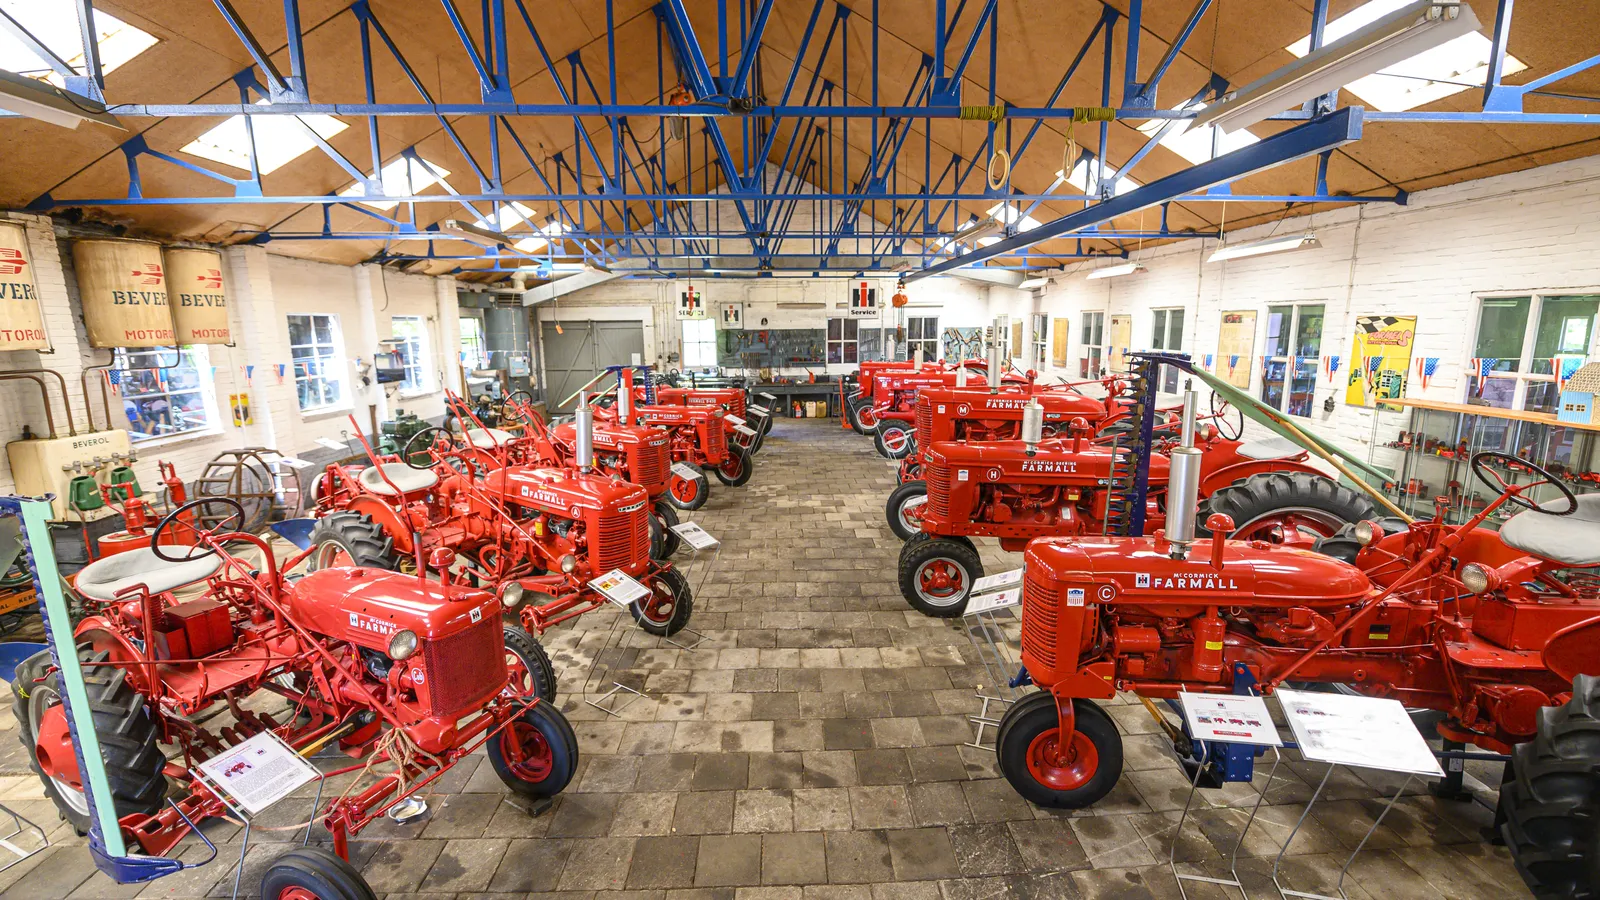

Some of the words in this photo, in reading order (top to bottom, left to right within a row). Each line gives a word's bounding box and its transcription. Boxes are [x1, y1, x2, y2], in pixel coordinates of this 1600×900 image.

[0, 330, 46, 341] TOROL
[73, 437, 110, 449] BEVEROL
[1022, 464, 1077, 472] FARMALL
[529, 490, 566, 506] FARMALL
[1154, 578, 1238, 589] FARMALL
[360, 619, 395, 634] FARMA
